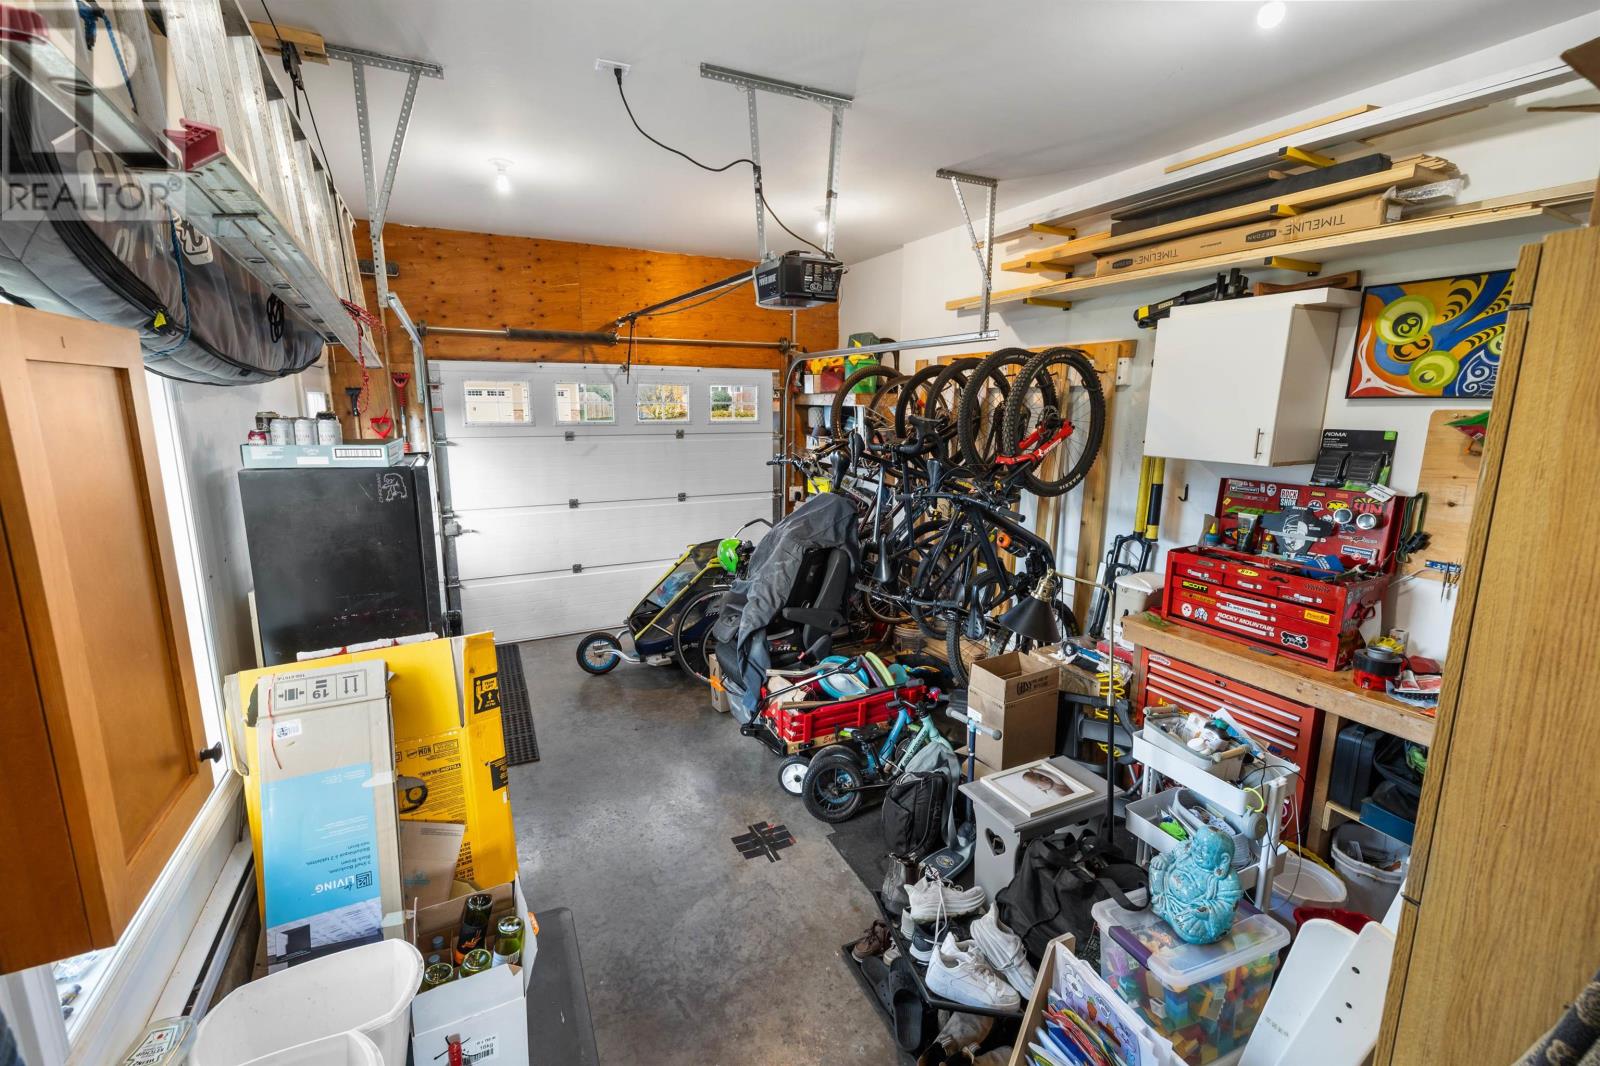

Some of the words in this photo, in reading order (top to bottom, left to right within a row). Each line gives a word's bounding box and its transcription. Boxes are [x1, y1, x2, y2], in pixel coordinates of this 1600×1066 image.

[1281, 214, 1346, 236] TIMELINE
[1138, 249, 1179, 264] TIMELINE
[1281, 489, 1298, 499] ROCK
[1182, 580, 1208, 591] SCOTT
[1217, 612, 1239, 622] ROCKY
[1239, 617, 1275, 632] MOUNTAIN
[312, 688, 330, 700] 19
[314, 875, 355, 893] LIVING
